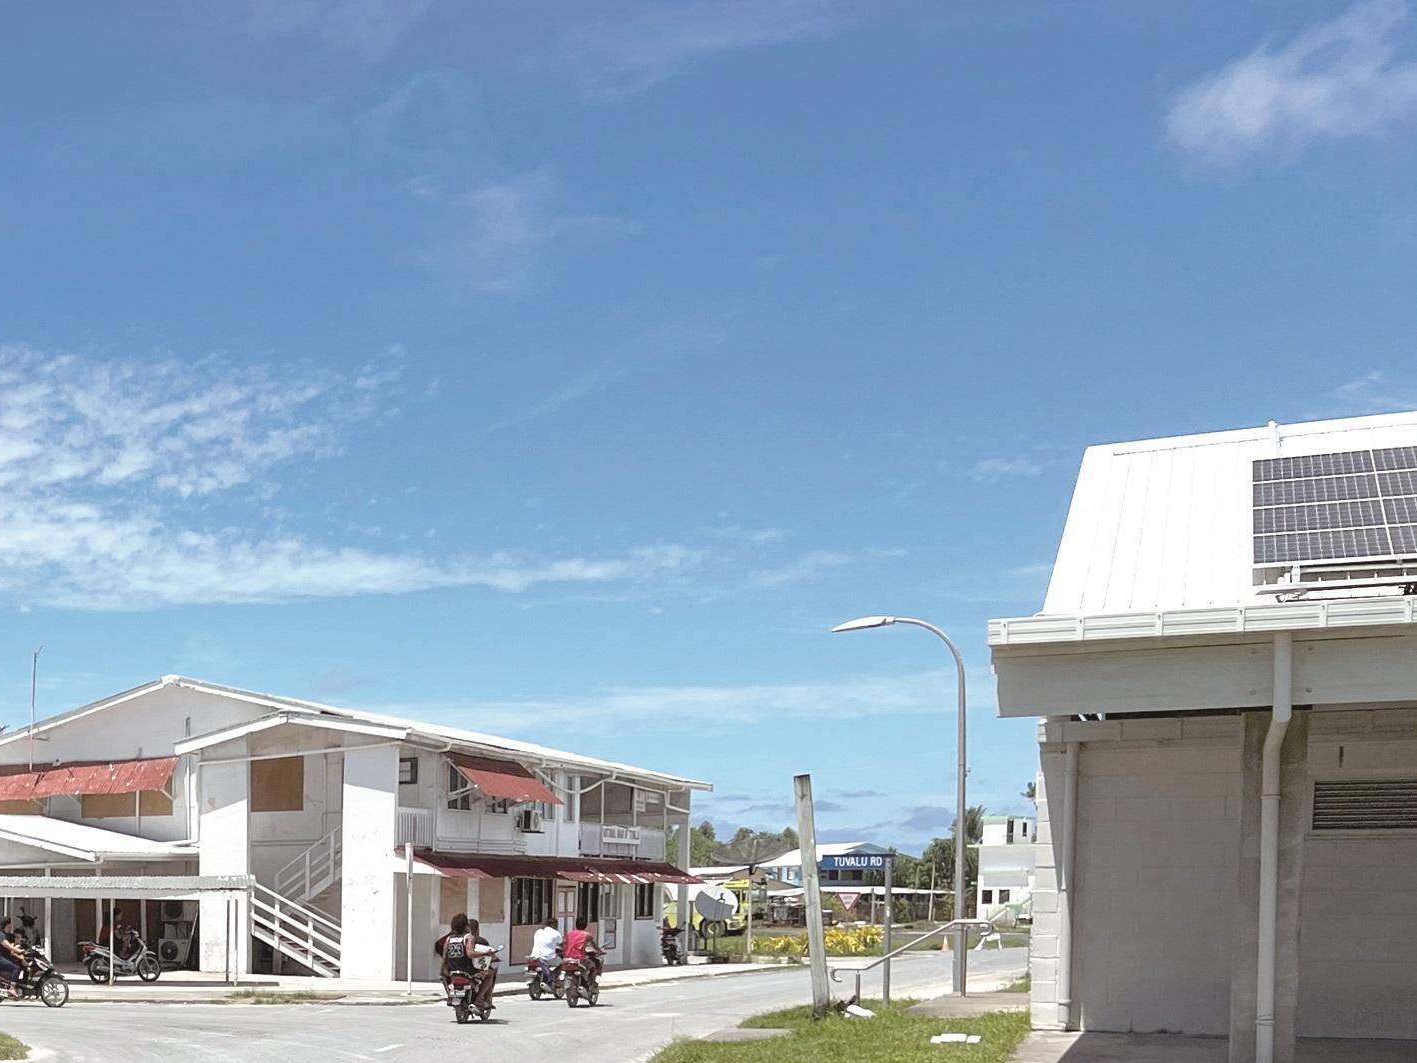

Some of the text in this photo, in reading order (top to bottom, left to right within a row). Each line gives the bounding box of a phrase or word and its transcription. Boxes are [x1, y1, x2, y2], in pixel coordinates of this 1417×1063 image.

[834, 856, 883, 867] TUVALU RD
[448, 943, 464, 958] 23
